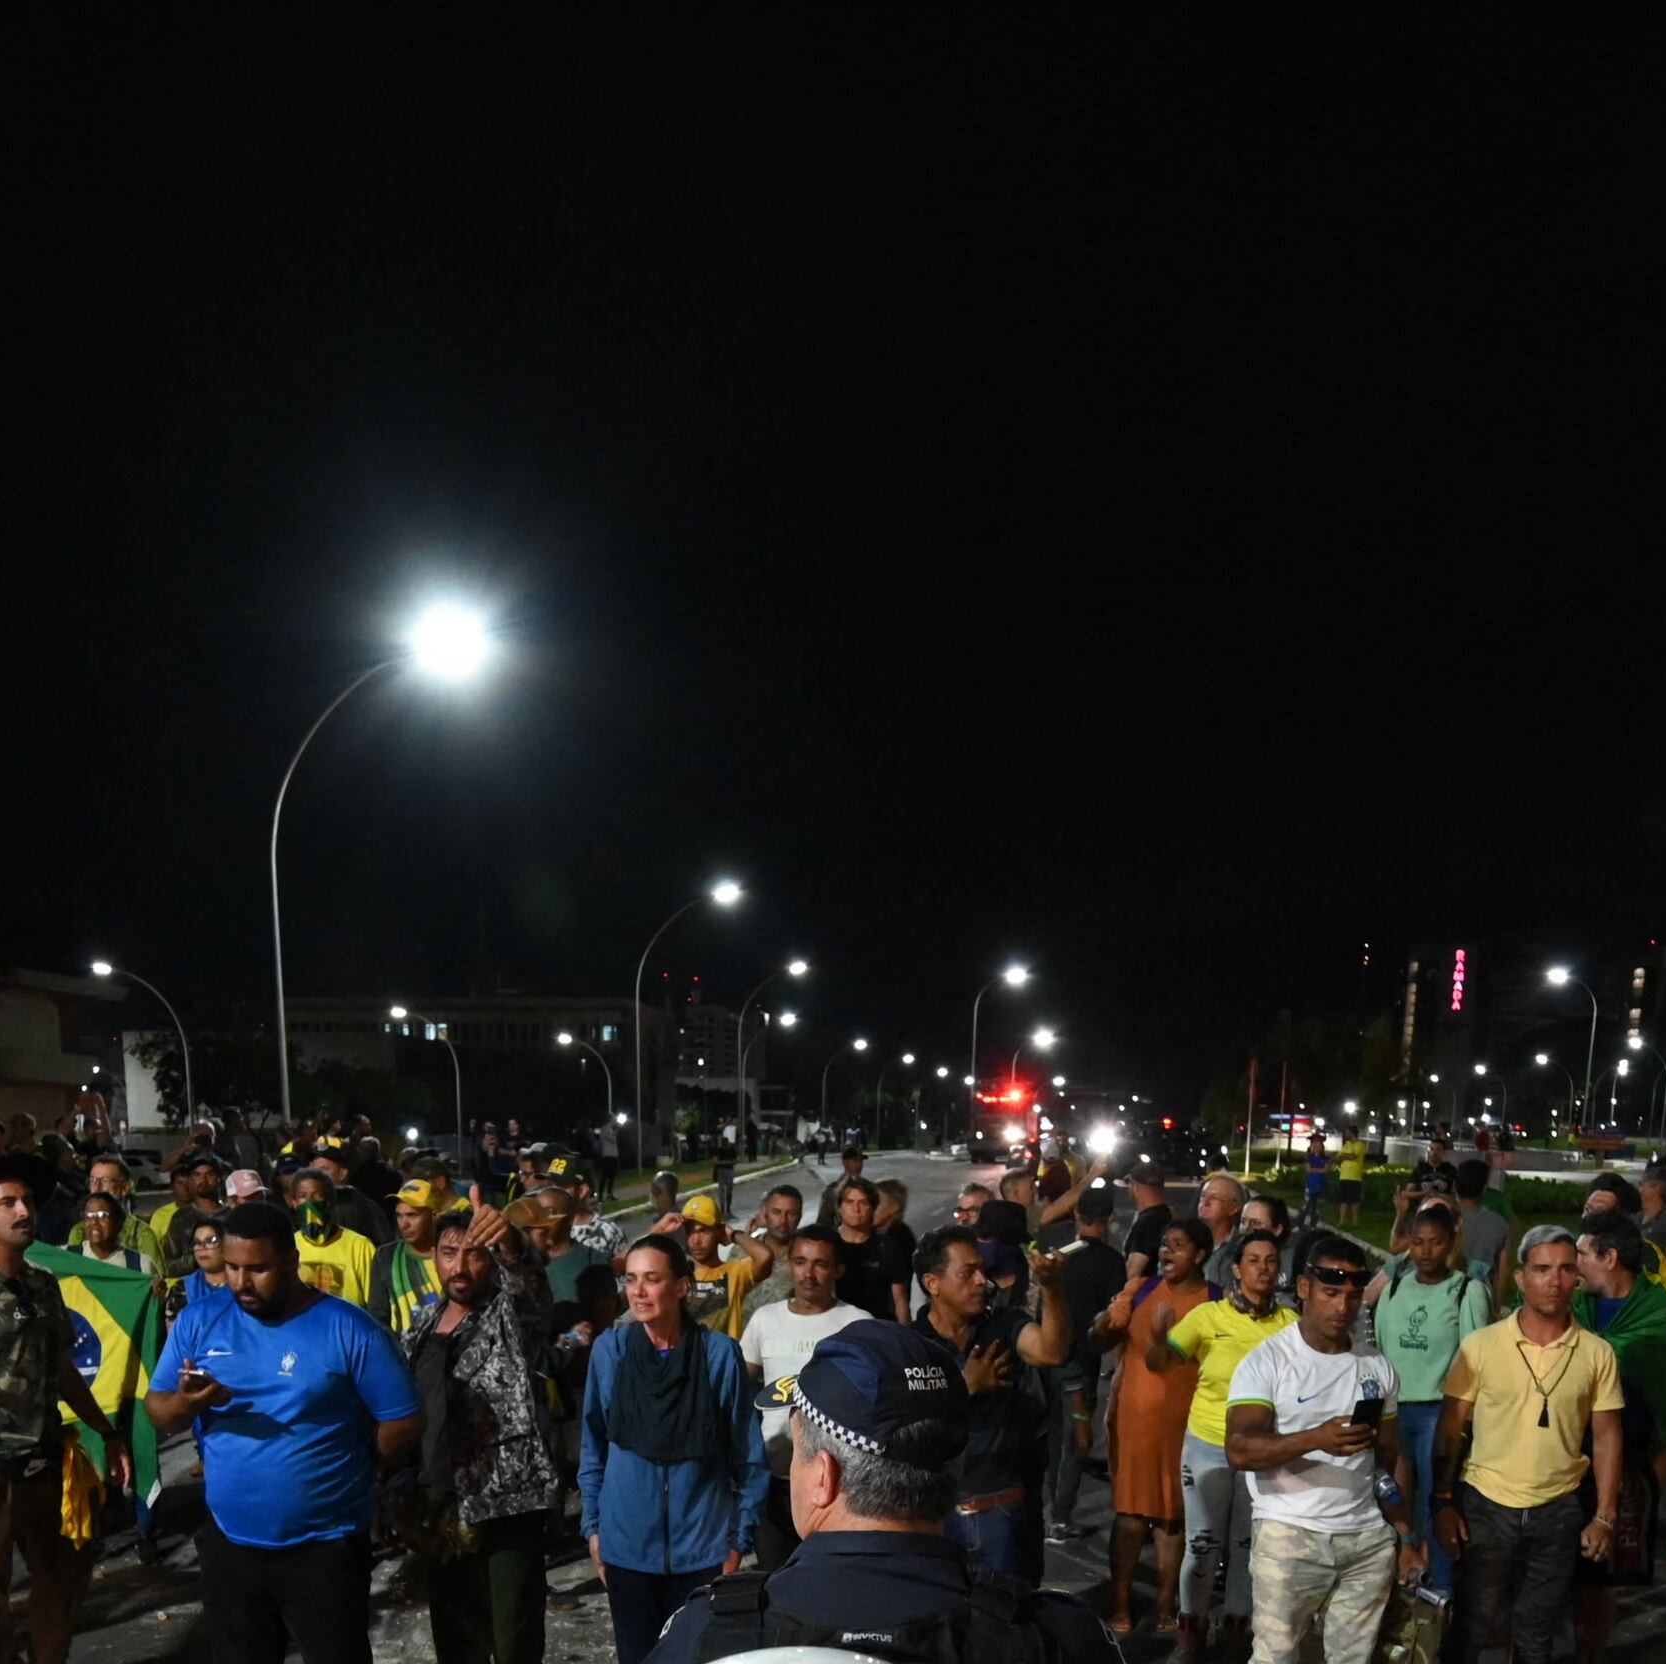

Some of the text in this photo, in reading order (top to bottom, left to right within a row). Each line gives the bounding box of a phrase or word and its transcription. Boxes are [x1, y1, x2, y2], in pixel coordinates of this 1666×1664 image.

[1451, 948, 1466, 1011] RAMADA
[547, 1157, 568, 1176] 22
[904, 1364, 946, 1379] POLÍCIA
[907, 1378, 949, 1391] MILITAR
